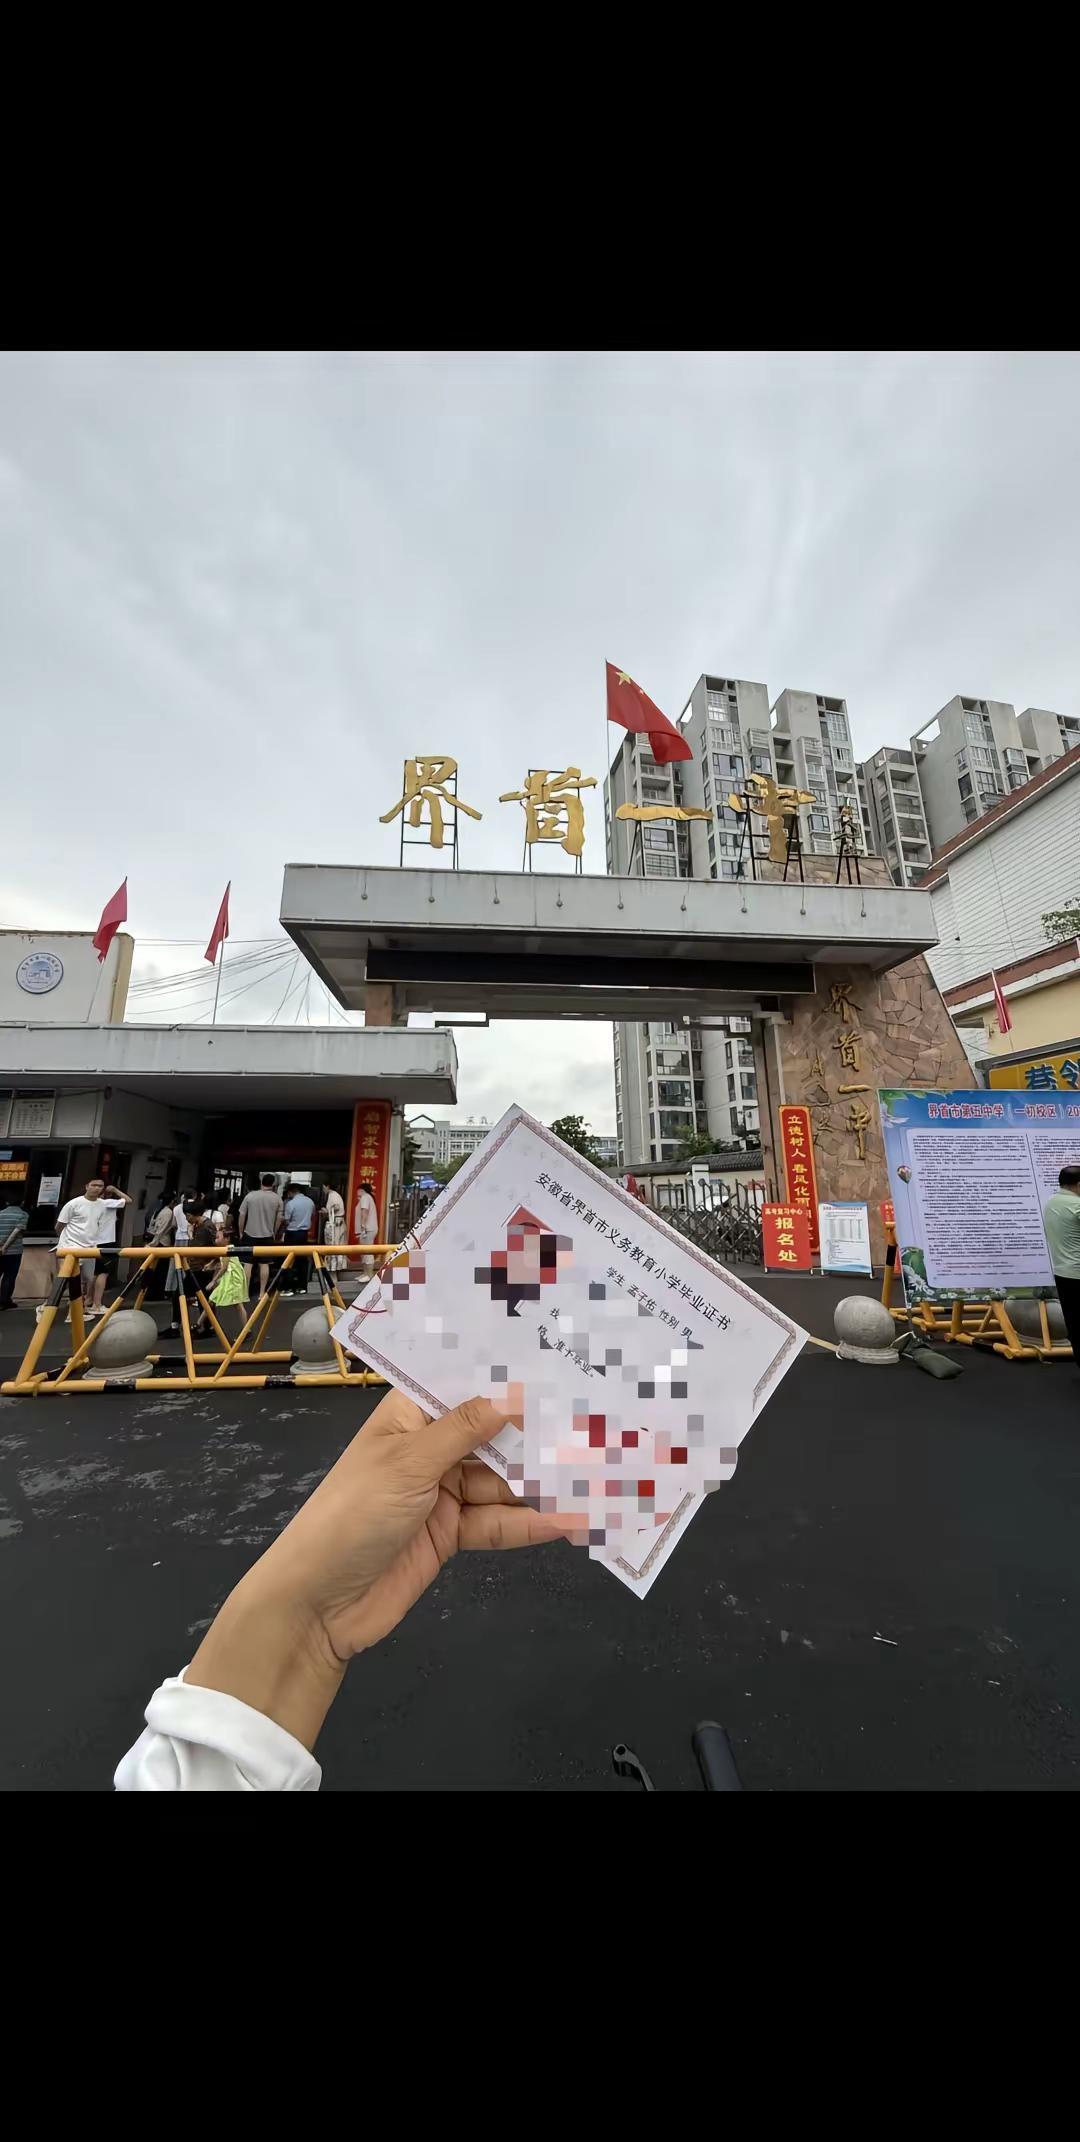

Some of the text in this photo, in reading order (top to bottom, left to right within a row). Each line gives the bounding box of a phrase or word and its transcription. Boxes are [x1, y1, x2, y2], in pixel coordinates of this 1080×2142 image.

[379, 755, 817, 864] 界首一中
[822, 984, 872, 1160] 界首一中
[788, 1115, 806, 1158] 立德树人
[536, 1172, 732, 1331] 安徽省界首市义务教育小学毕业证书
[775, 1217, 798, 1262] 报名处
[606, 1266, 625, 1287] 学生
[659, 1309, 680, 1330] 性别
[681, 1326, 693, 1340] 男
